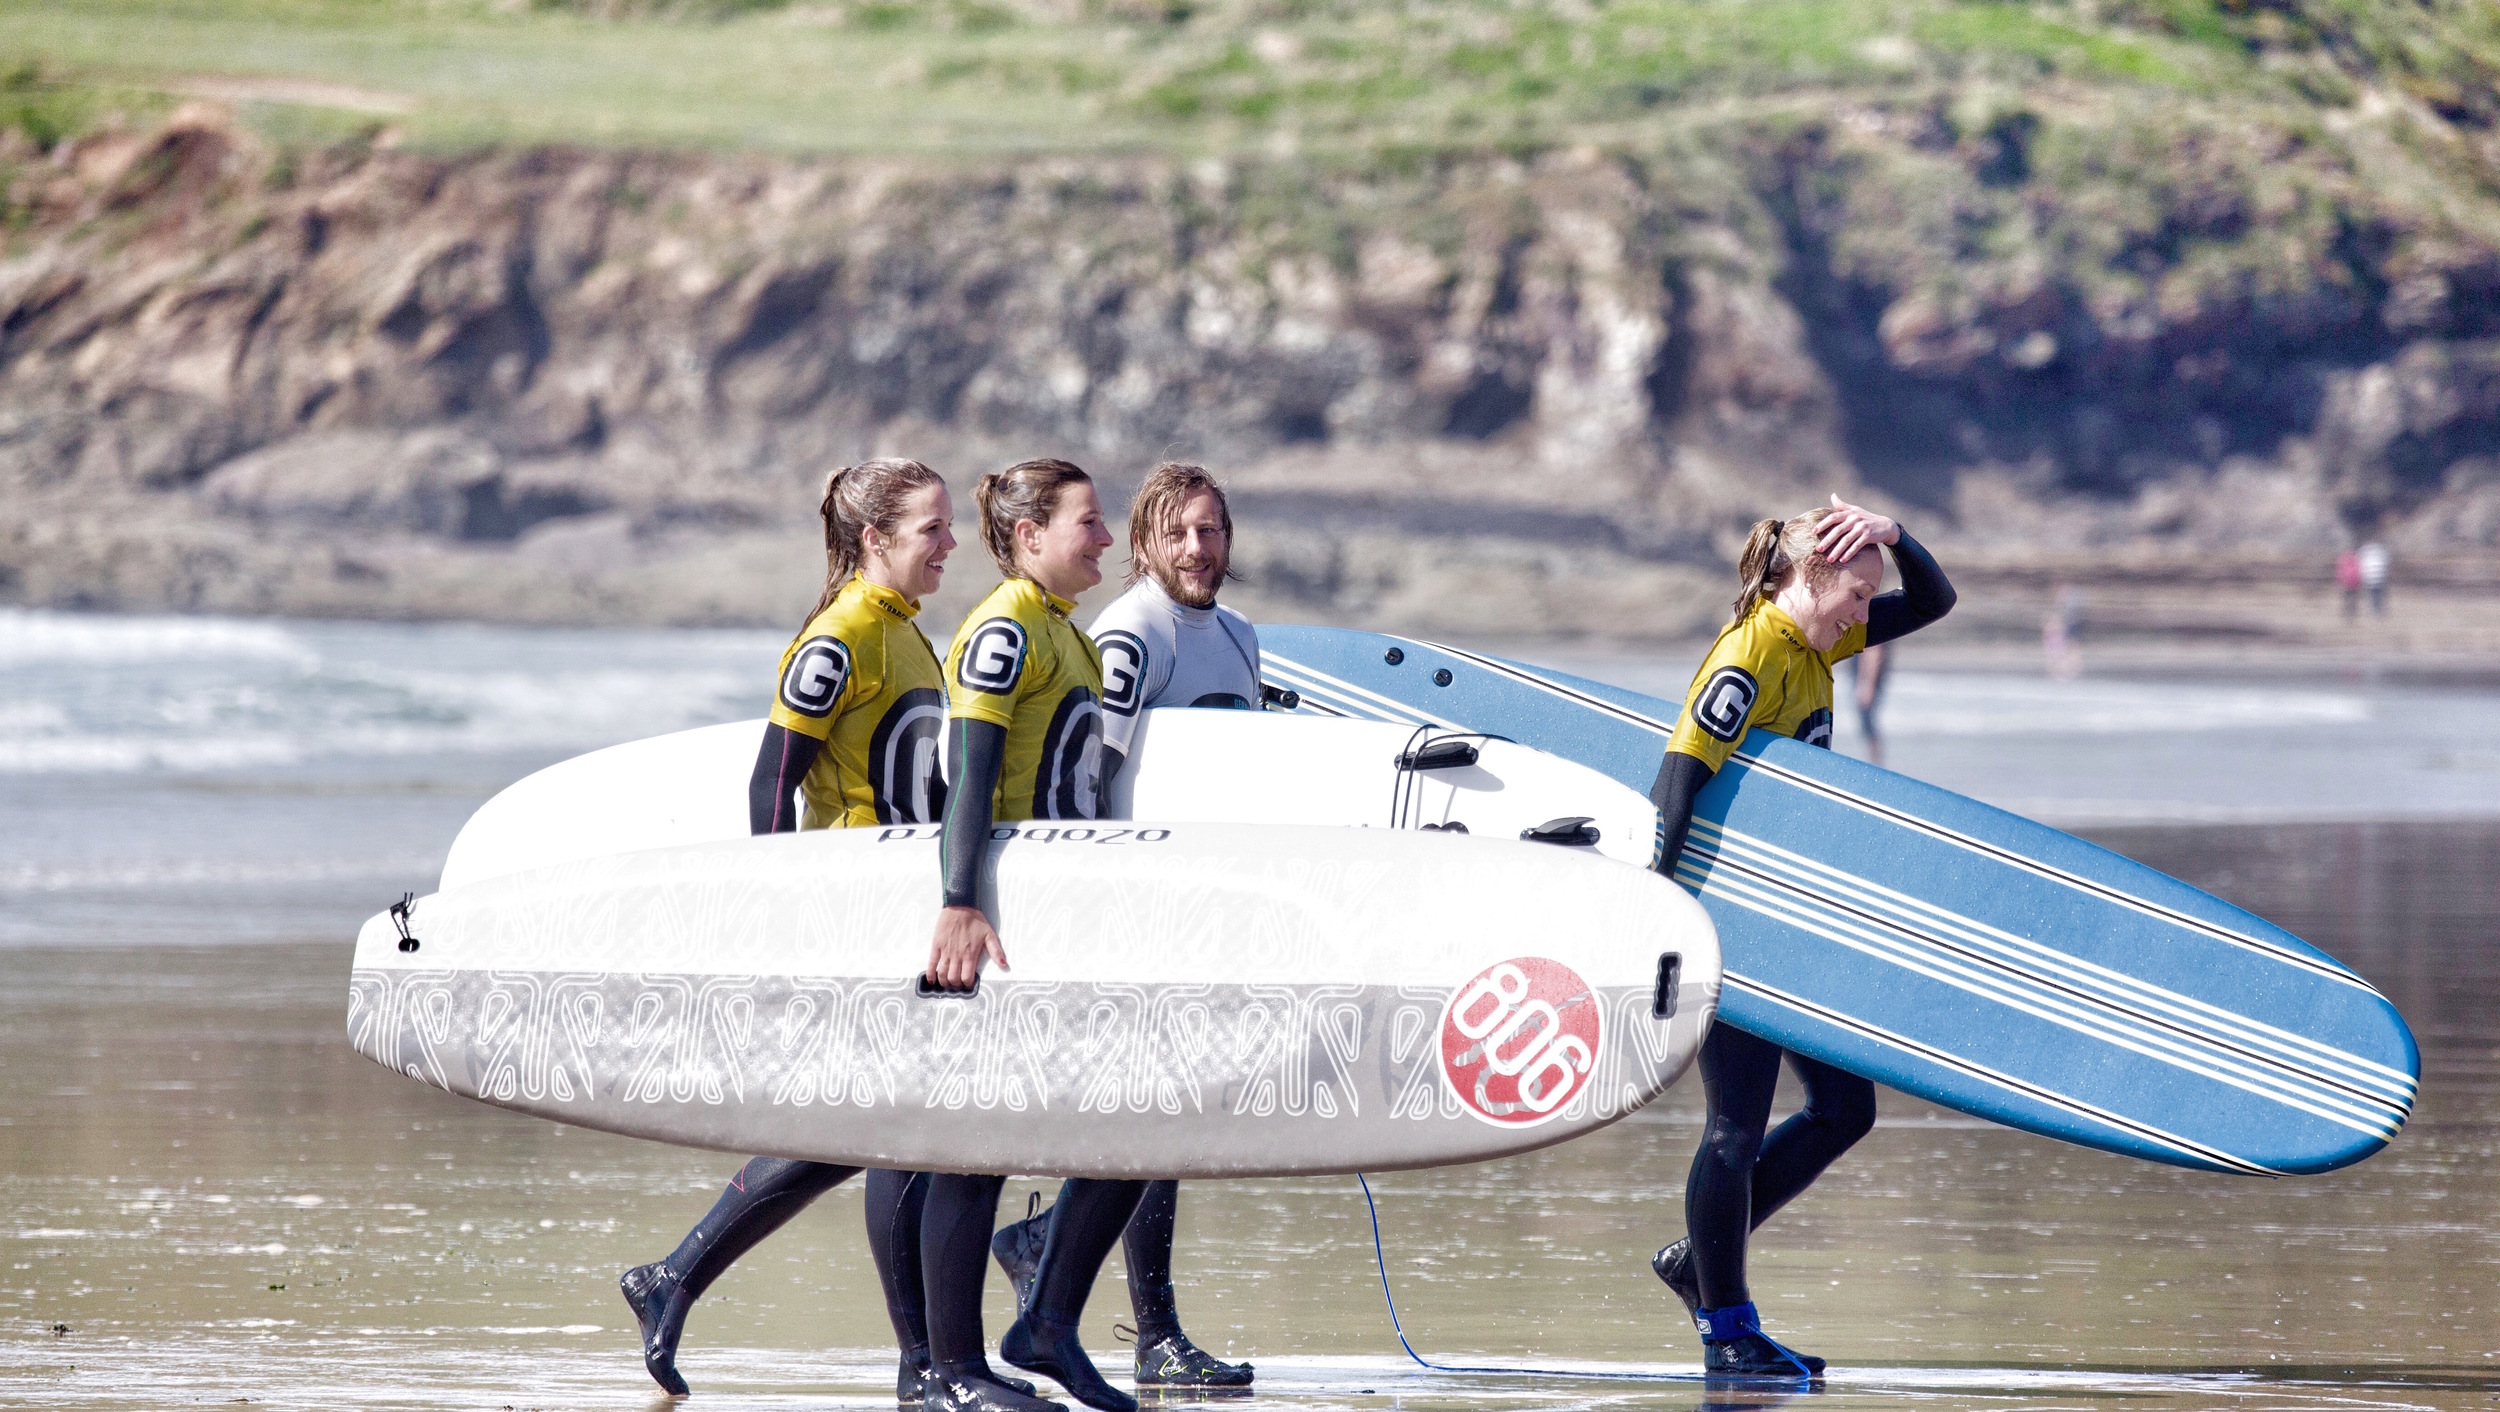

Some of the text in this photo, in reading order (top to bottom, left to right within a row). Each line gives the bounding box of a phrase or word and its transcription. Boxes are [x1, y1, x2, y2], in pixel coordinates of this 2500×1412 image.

[788, 645, 845, 707] G
[965, 626, 1019, 684] G
[1097, 639, 1140, 704] G
[1701, 675, 1753, 733] G
[1452, 963, 1592, 1113] 806
